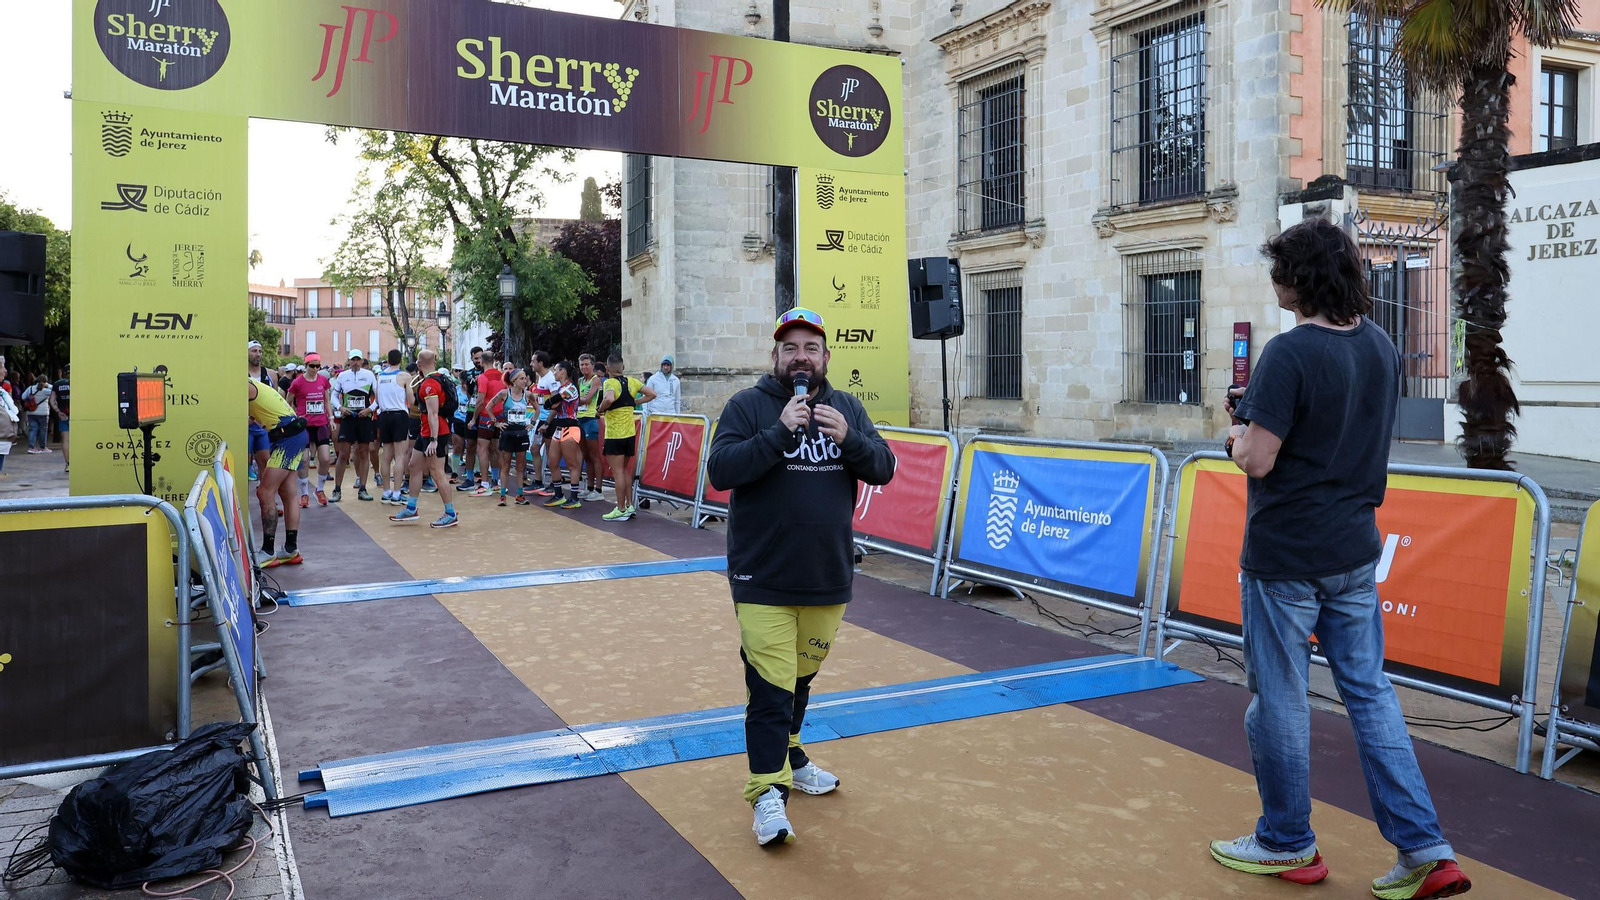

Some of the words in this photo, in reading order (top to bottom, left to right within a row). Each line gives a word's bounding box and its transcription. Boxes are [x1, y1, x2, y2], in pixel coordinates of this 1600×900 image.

[107, 13, 219, 56] Sherry
[127, 37, 201, 57] Maratón
[455, 36, 640, 113] Sherry
[489, 82, 612, 117] Maratón
[816, 98, 885, 130] Sherry
[828, 117, 874, 131] Maratón
[140, 128, 222, 144] Ayuntamiento
[140, 139, 154, 148] de
[157, 139, 187, 151] Jerez
[153, 185, 222, 202] Diputación
[838, 186, 890, 198] Ayuntamiento
[849, 195, 868, 204] Jerez
[153, 203, 170, 214] de
[175, 202, 210, 217] Cádiz
[1509, 199, 1600, 223] ALCAZA
[847, 230, 890, 243] Diputación
[1546, 222, 1575, 240] DE
[173, 244, 204, 252] JEREZ
[847, 243, 858, 252] de
[861, 242, 883, 255] Cádiz
[1527, 239, 1598, 261] JEREZ
[836, 329, 874, 343] HSN
[96, 440, 171, 450] GONZÁEZ
[188, 433, 220, 451] VALDESPIN
[113, 451, 155, 460] BYAS
[194, 456, 215, 464] JERE
[787, 464, 818, 472] CONTANDO
[819, 464, 844, 472] HISTORIAS
[1023, 499, 1112, 526] Ayuntamiento
[1021, 518, 1036, 534] de
[1037, 520, 1071, 540] Jerez
